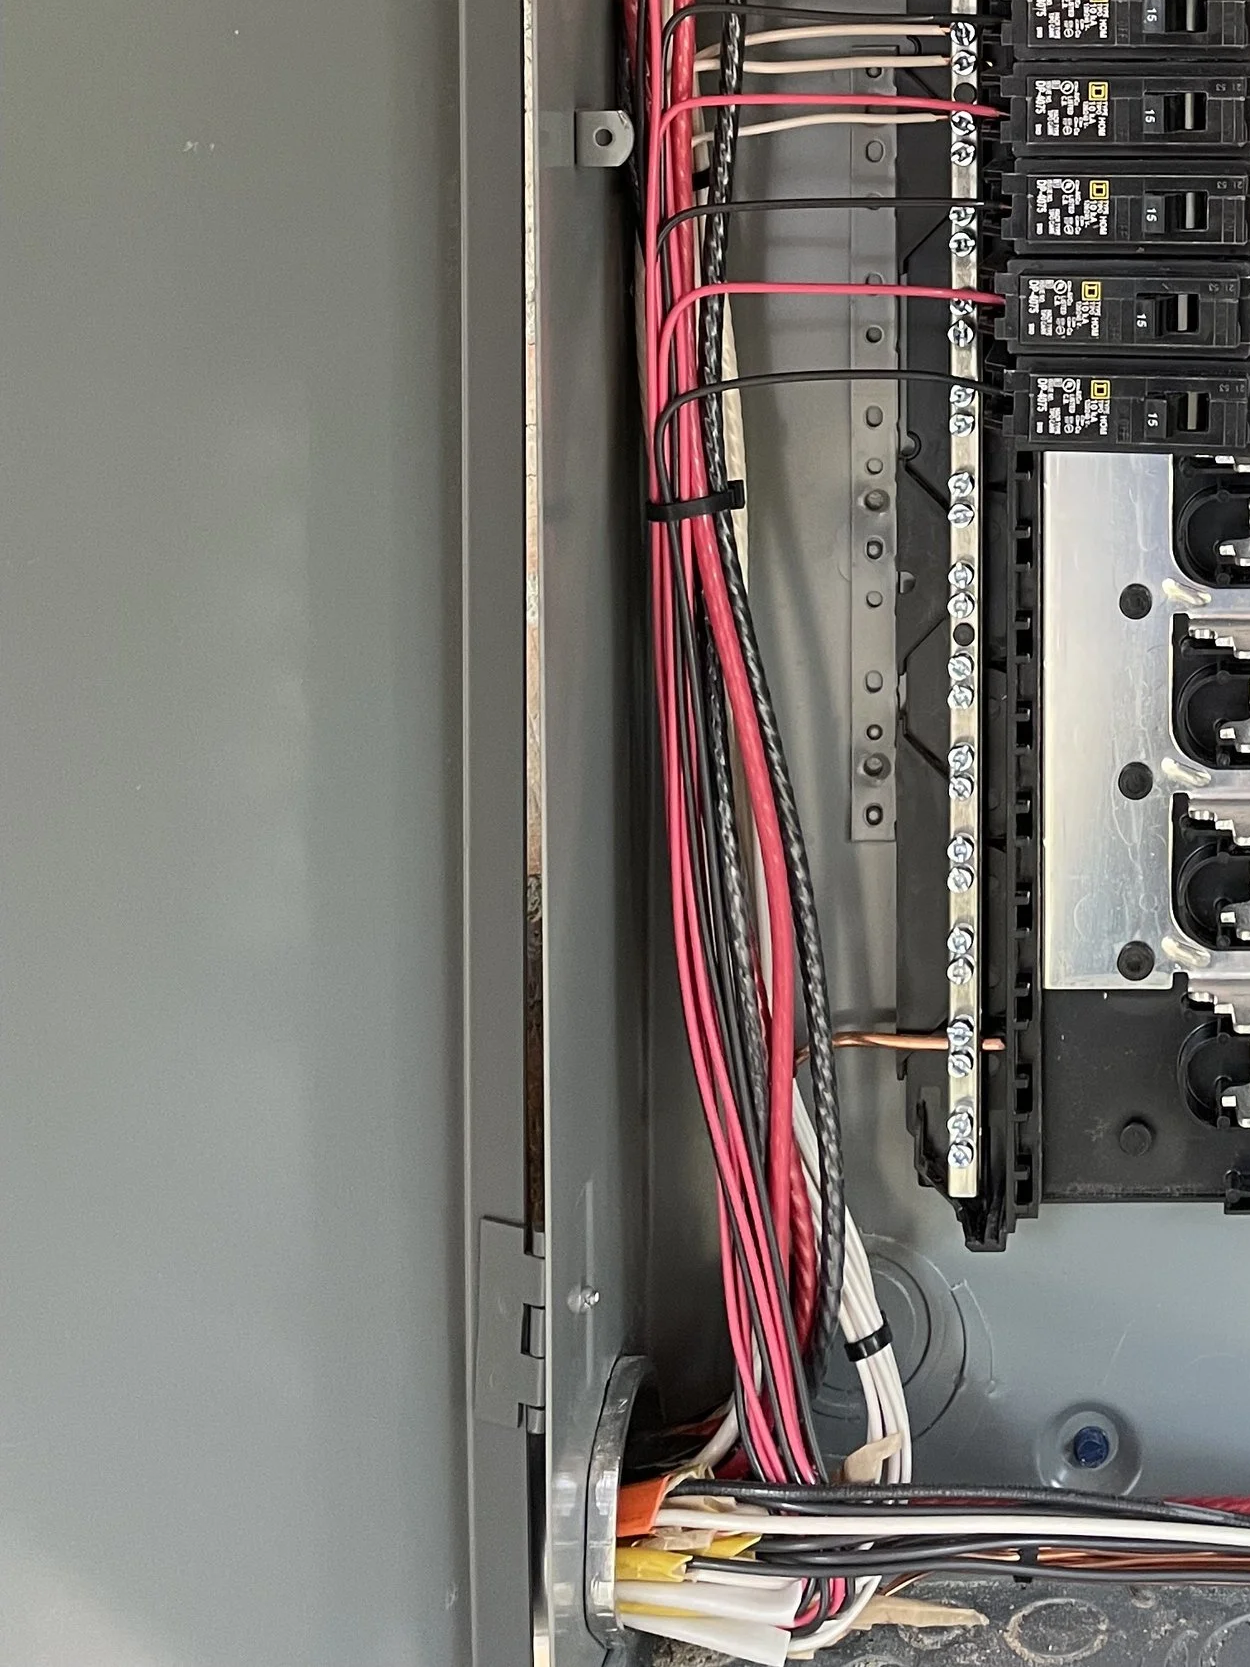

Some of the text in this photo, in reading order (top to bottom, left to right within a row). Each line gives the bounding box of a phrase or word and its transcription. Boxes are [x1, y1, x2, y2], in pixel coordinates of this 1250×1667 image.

[1146, 8, 1156, 22] 15
[1035, 80, 1046, 114] DP-4075
[1145, 109, 1155, 123] 15
[1098, 117, 1106, 136] HOM
[1036, 180, 1046, 213] DP-4075
[1146, 208, 1157, 222] 15
[1028, 280, 1038, 313] DP-4075
[1091, 317, 1099, 336] HOM
[1137, 313, 1147, 328] 15
[1037, 378, 1048, 412] DP-4075
[1100, 416, 1108, 435] HOM
[1148, 412, 1158, 427] 15
